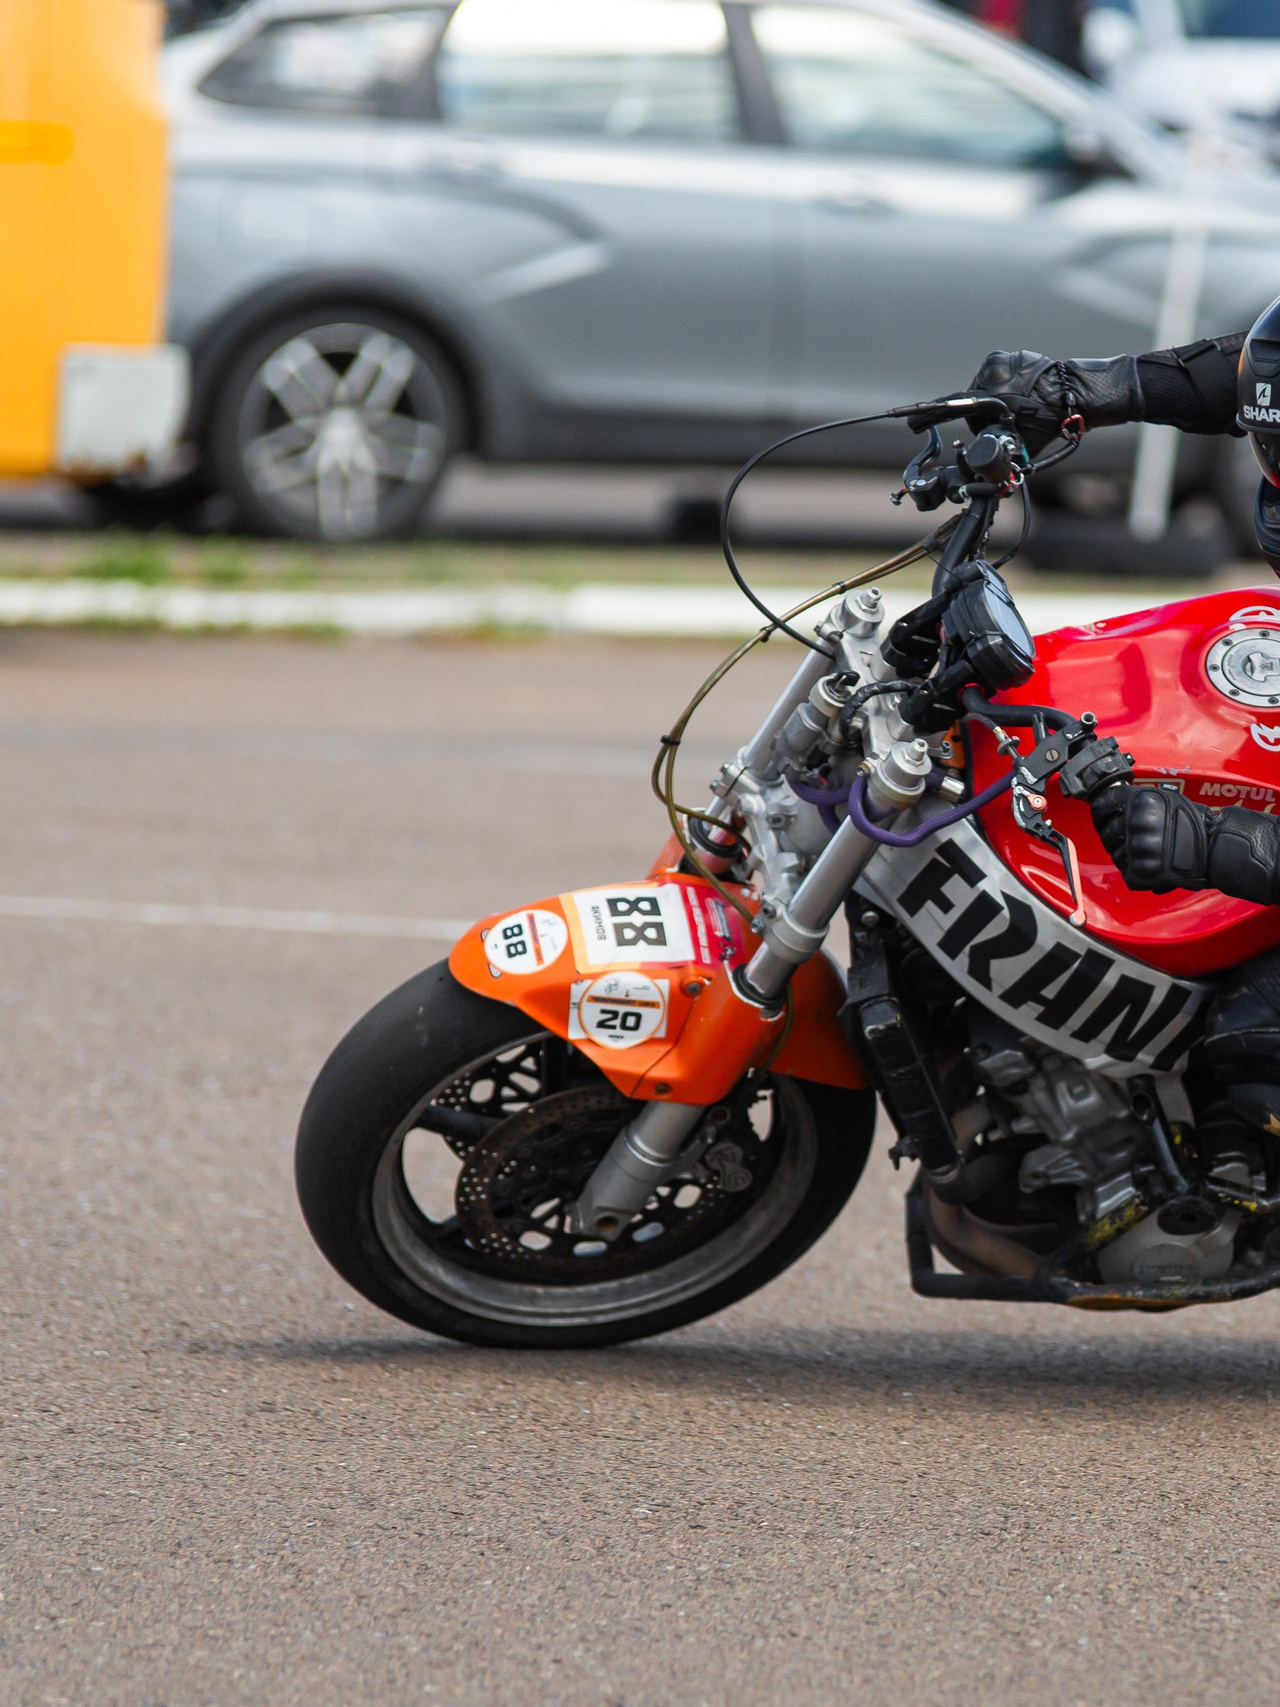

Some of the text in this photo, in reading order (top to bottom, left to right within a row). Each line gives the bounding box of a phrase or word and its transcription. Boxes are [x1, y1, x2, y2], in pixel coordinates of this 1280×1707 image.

[1199, 782, 1276, 802] MOTUL
[606, 896, 667, 947] 88
[502, 923, 527, 959] 88
[595, 1008, 642, 1032] 20
